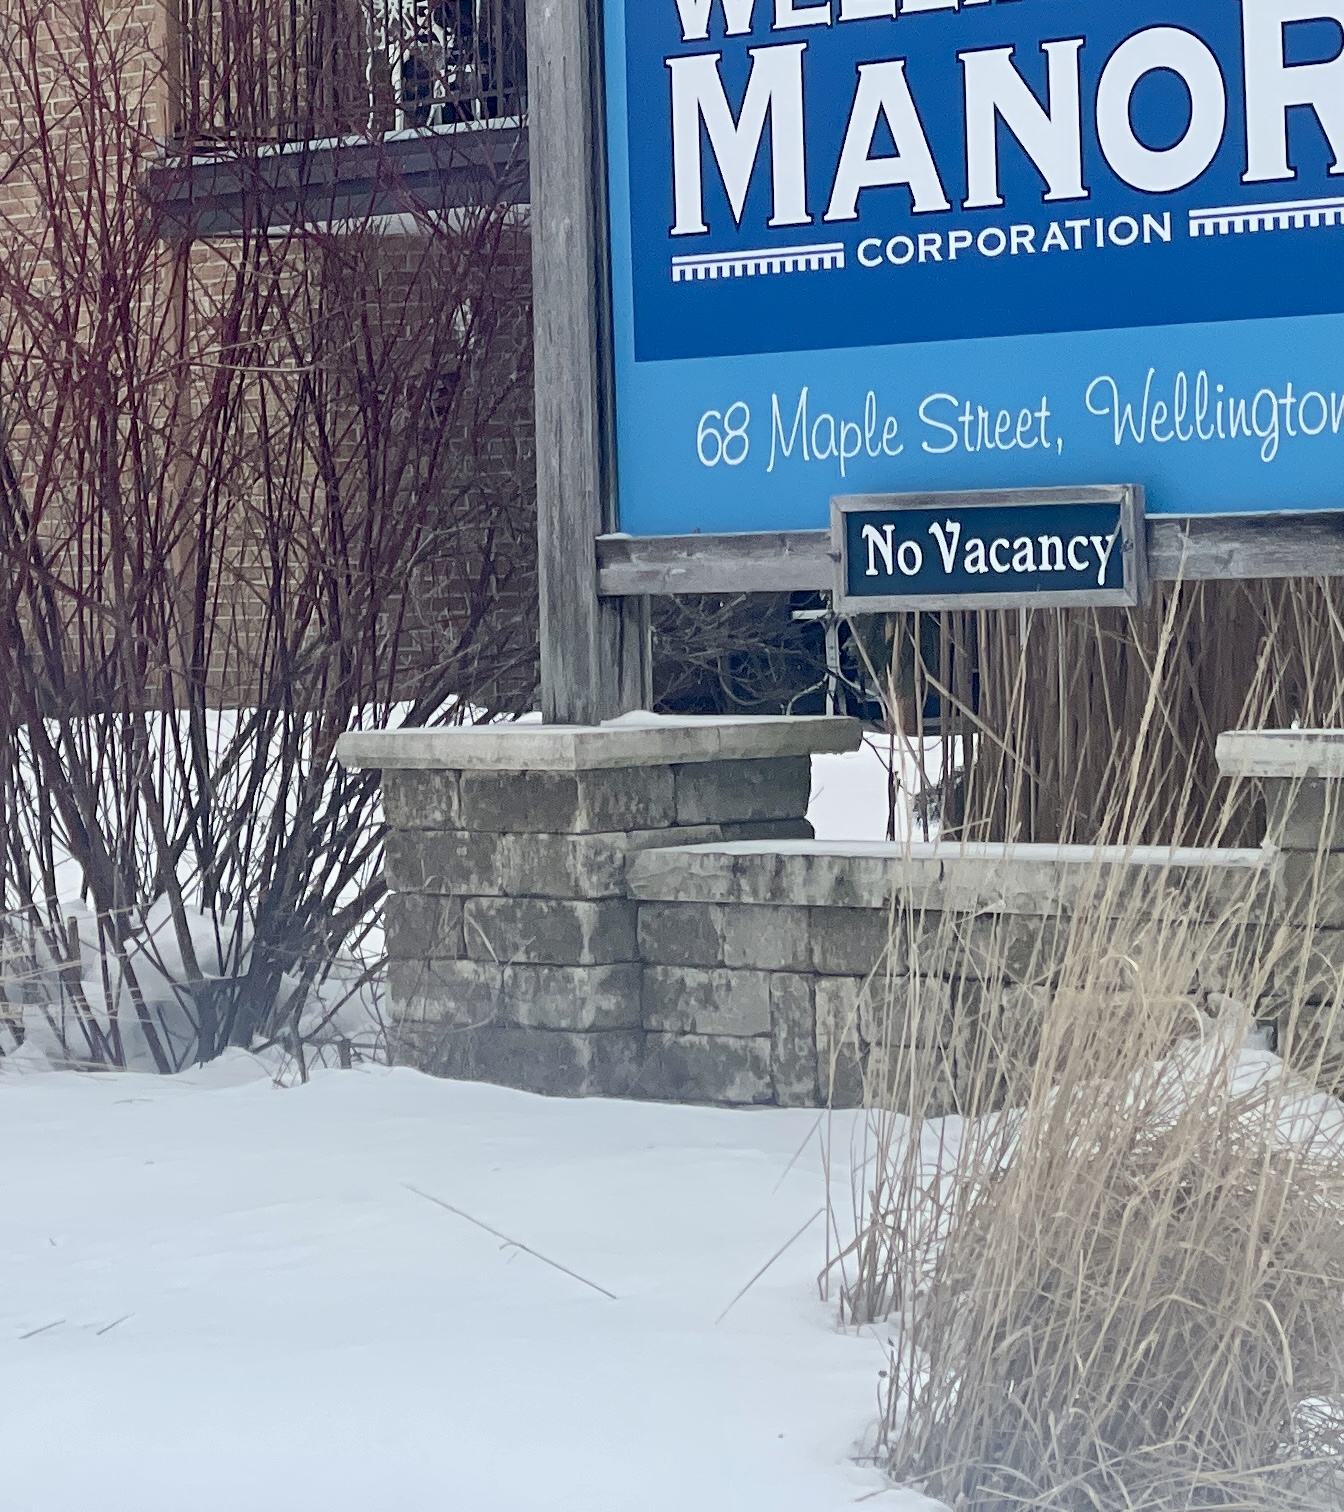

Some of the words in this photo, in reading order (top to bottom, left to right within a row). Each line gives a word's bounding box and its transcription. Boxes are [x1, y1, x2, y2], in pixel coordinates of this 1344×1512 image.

[857, 211, 1173, 268] CORPORATION
[695, 401, 750, 467] 68
[767, 386, 904, 477] Maple
[919, 392, 1065, 455] Street,
[863, 521, 922, 577] No
[929, 518, 1116, 585] Vacancy
